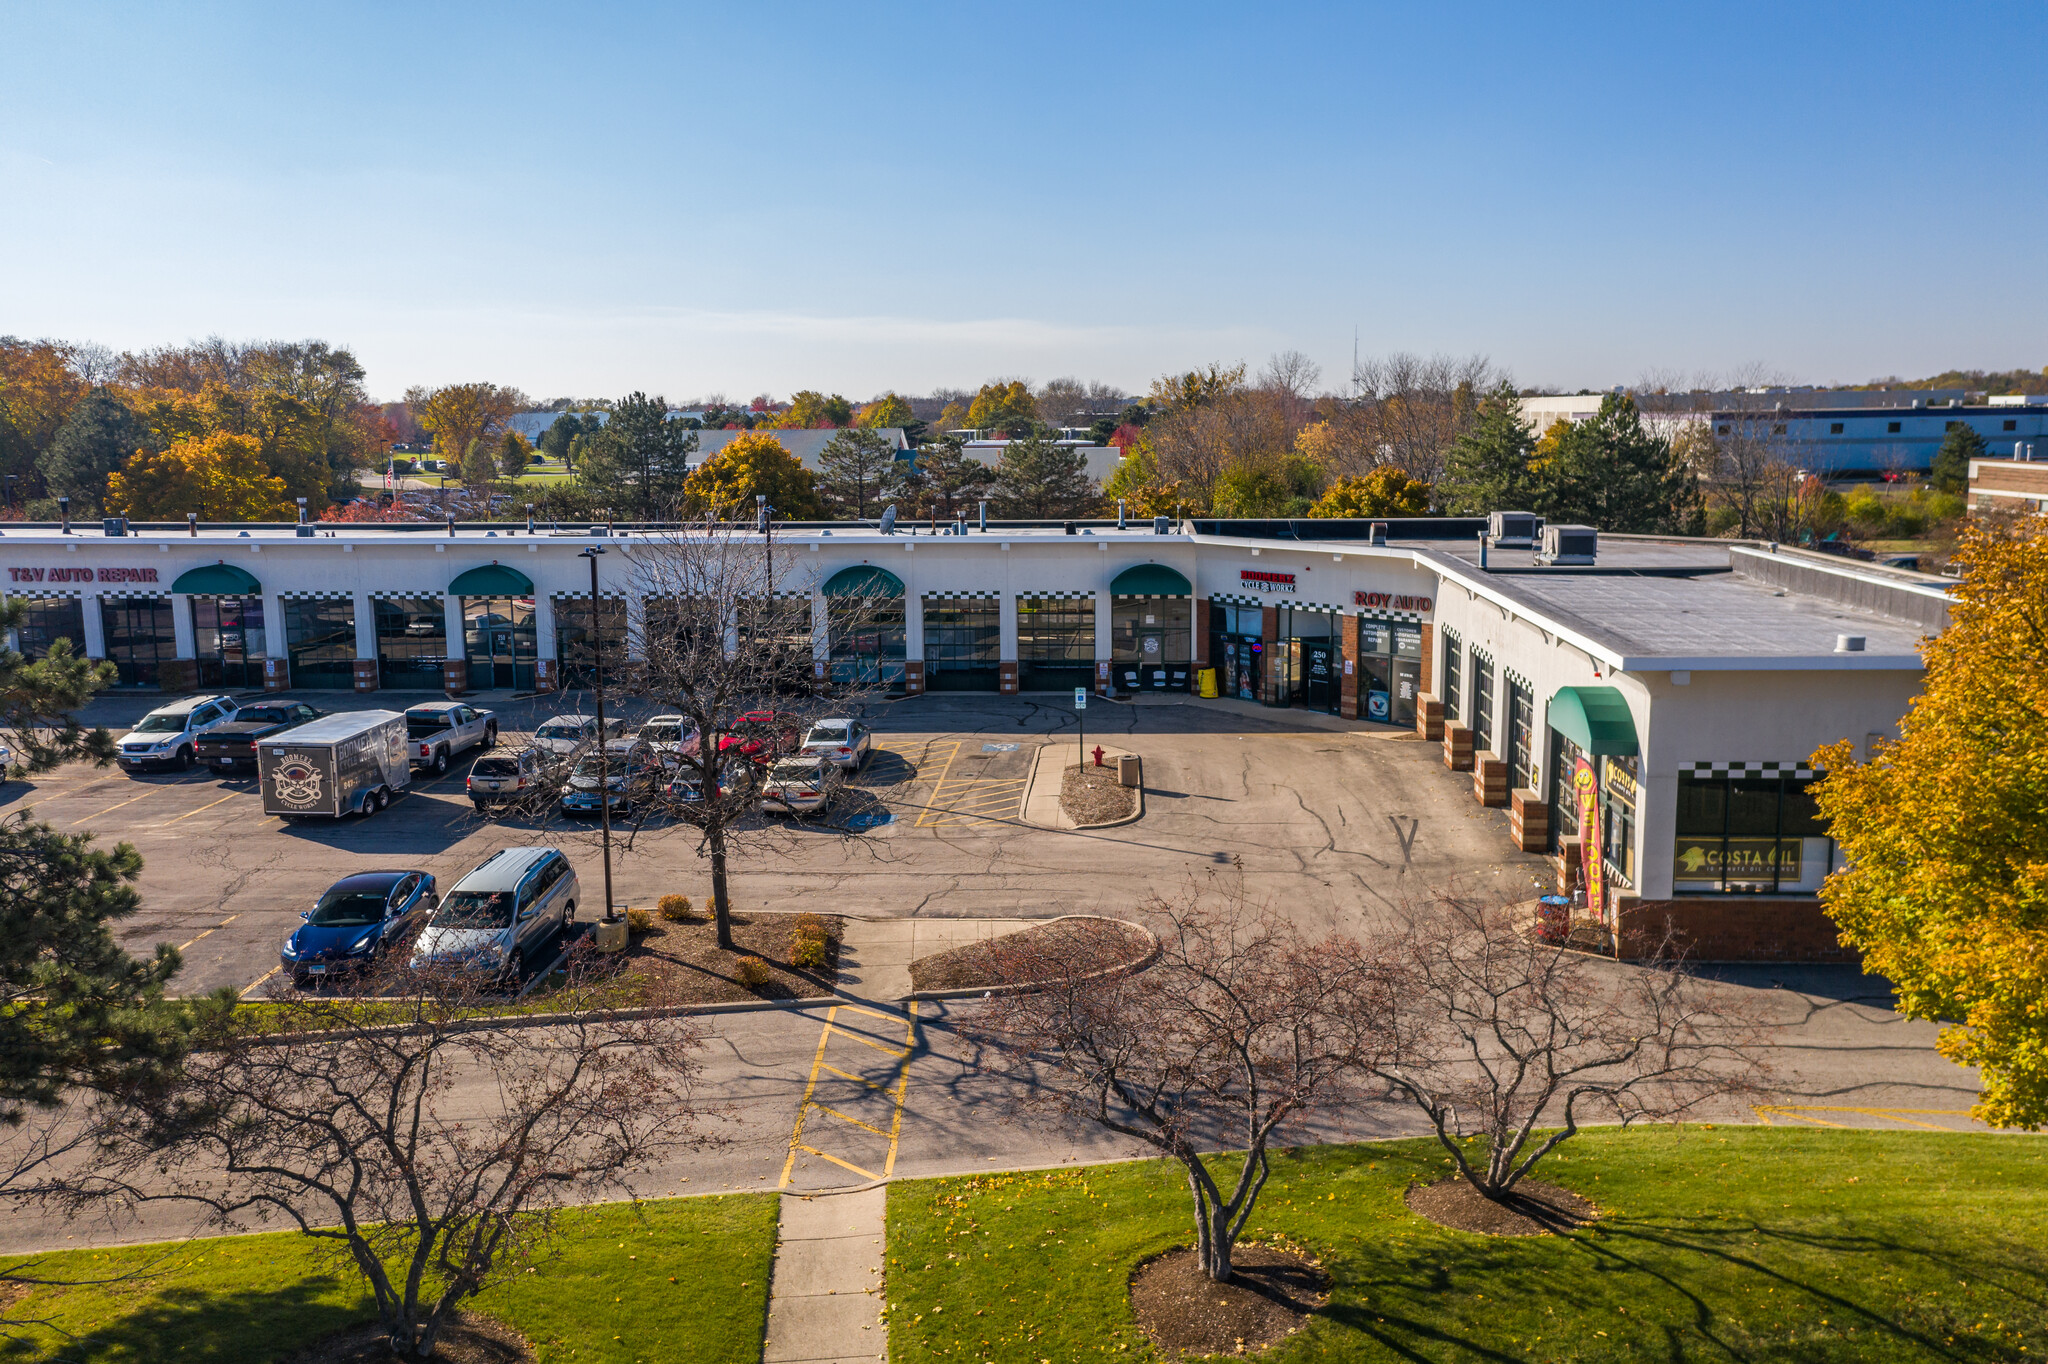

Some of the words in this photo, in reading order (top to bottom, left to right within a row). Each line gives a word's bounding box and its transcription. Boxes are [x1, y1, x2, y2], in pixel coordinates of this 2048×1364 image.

[8, 568, 44, 582] T&V
[48, 568, 93, 582] AUTO
[97, 568, 158, 582] REPAIR
[1240, 570, 1296, 584] BOOMERZ
[1240, 580, 1260, 590] CYCLE
[1270, 582, 1295, 592] WORKZ
[1354, 591, 1391, 609] ROY
[1393, 594, 1432, 611] AUTO
[1313, 650, 1326, 658] 250
[280, 754, 312, 764] BOOMERZ
